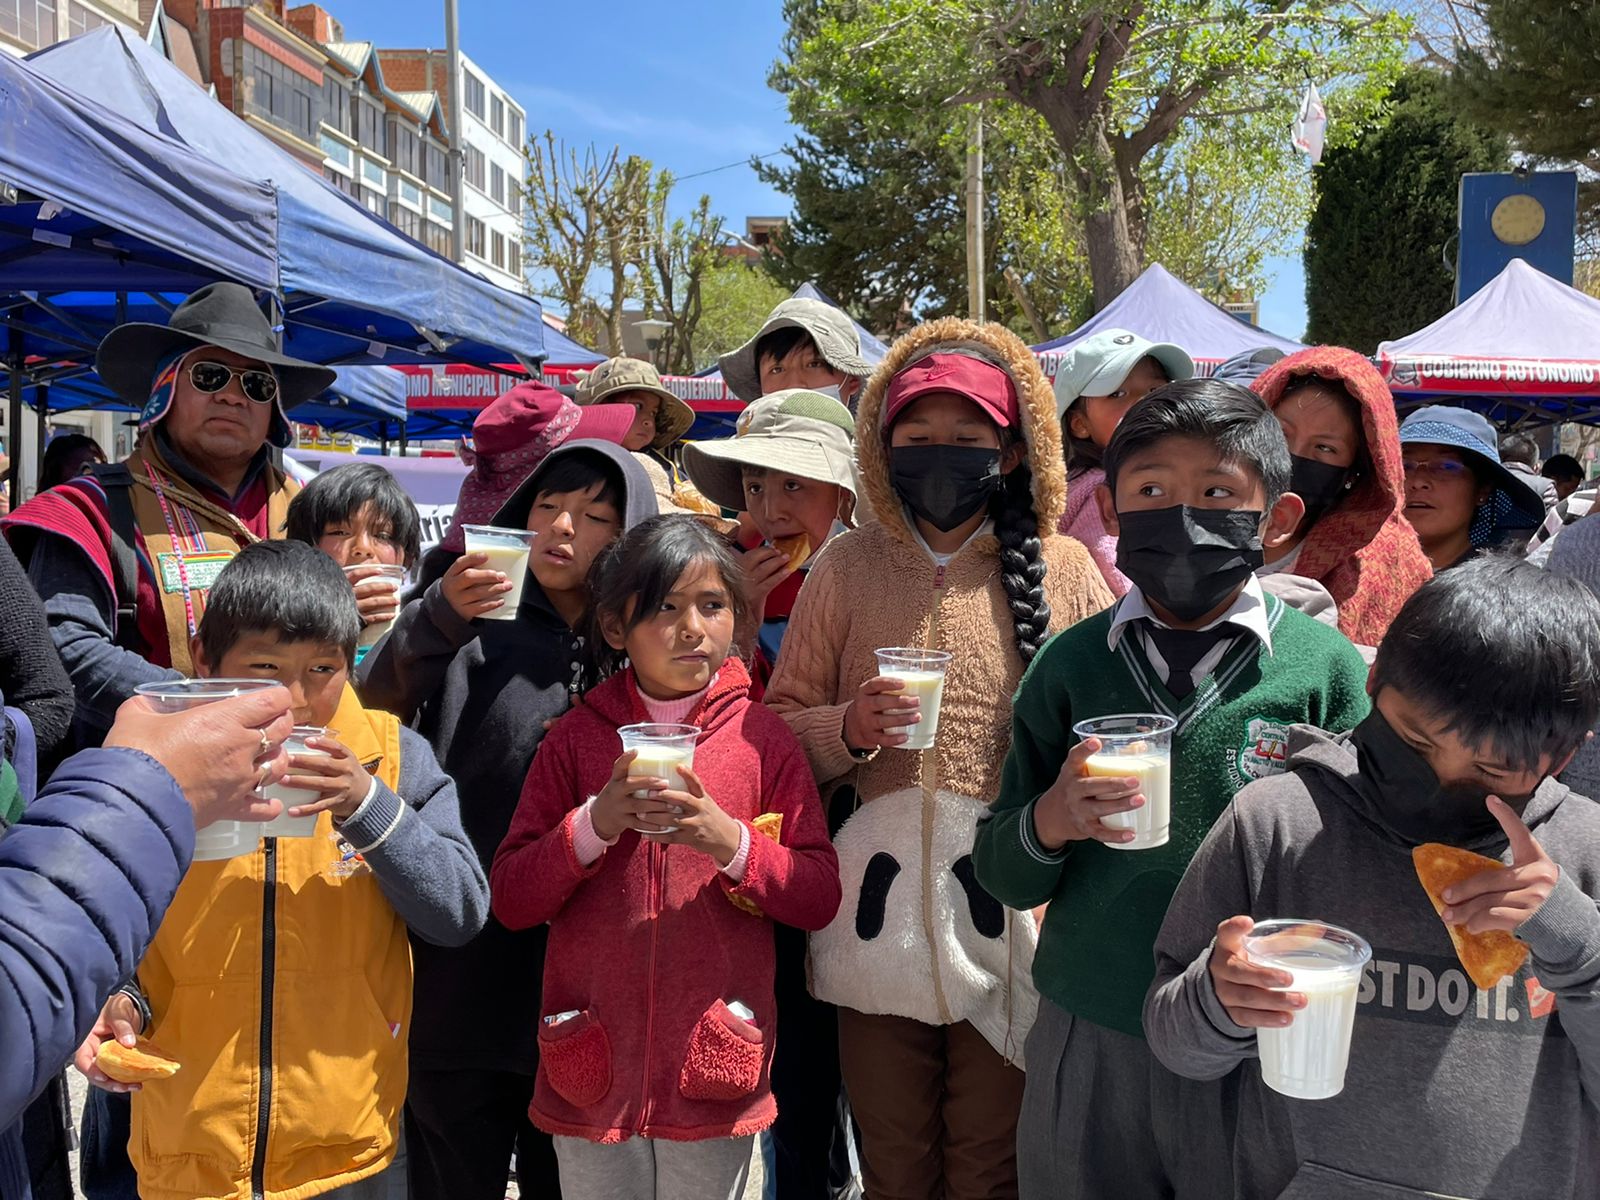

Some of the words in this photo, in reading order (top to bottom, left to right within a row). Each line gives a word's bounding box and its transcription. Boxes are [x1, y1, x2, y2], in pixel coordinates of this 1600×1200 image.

[1421, 360, 1499, 380] GOBIERNO
[663, 378, 724, 400] GOBIERNO
[420, 509, 453, 542] ría
[1227, 749, 1245, 788] ESTUDIO
[1407, 964, 1469, 1016] DO
